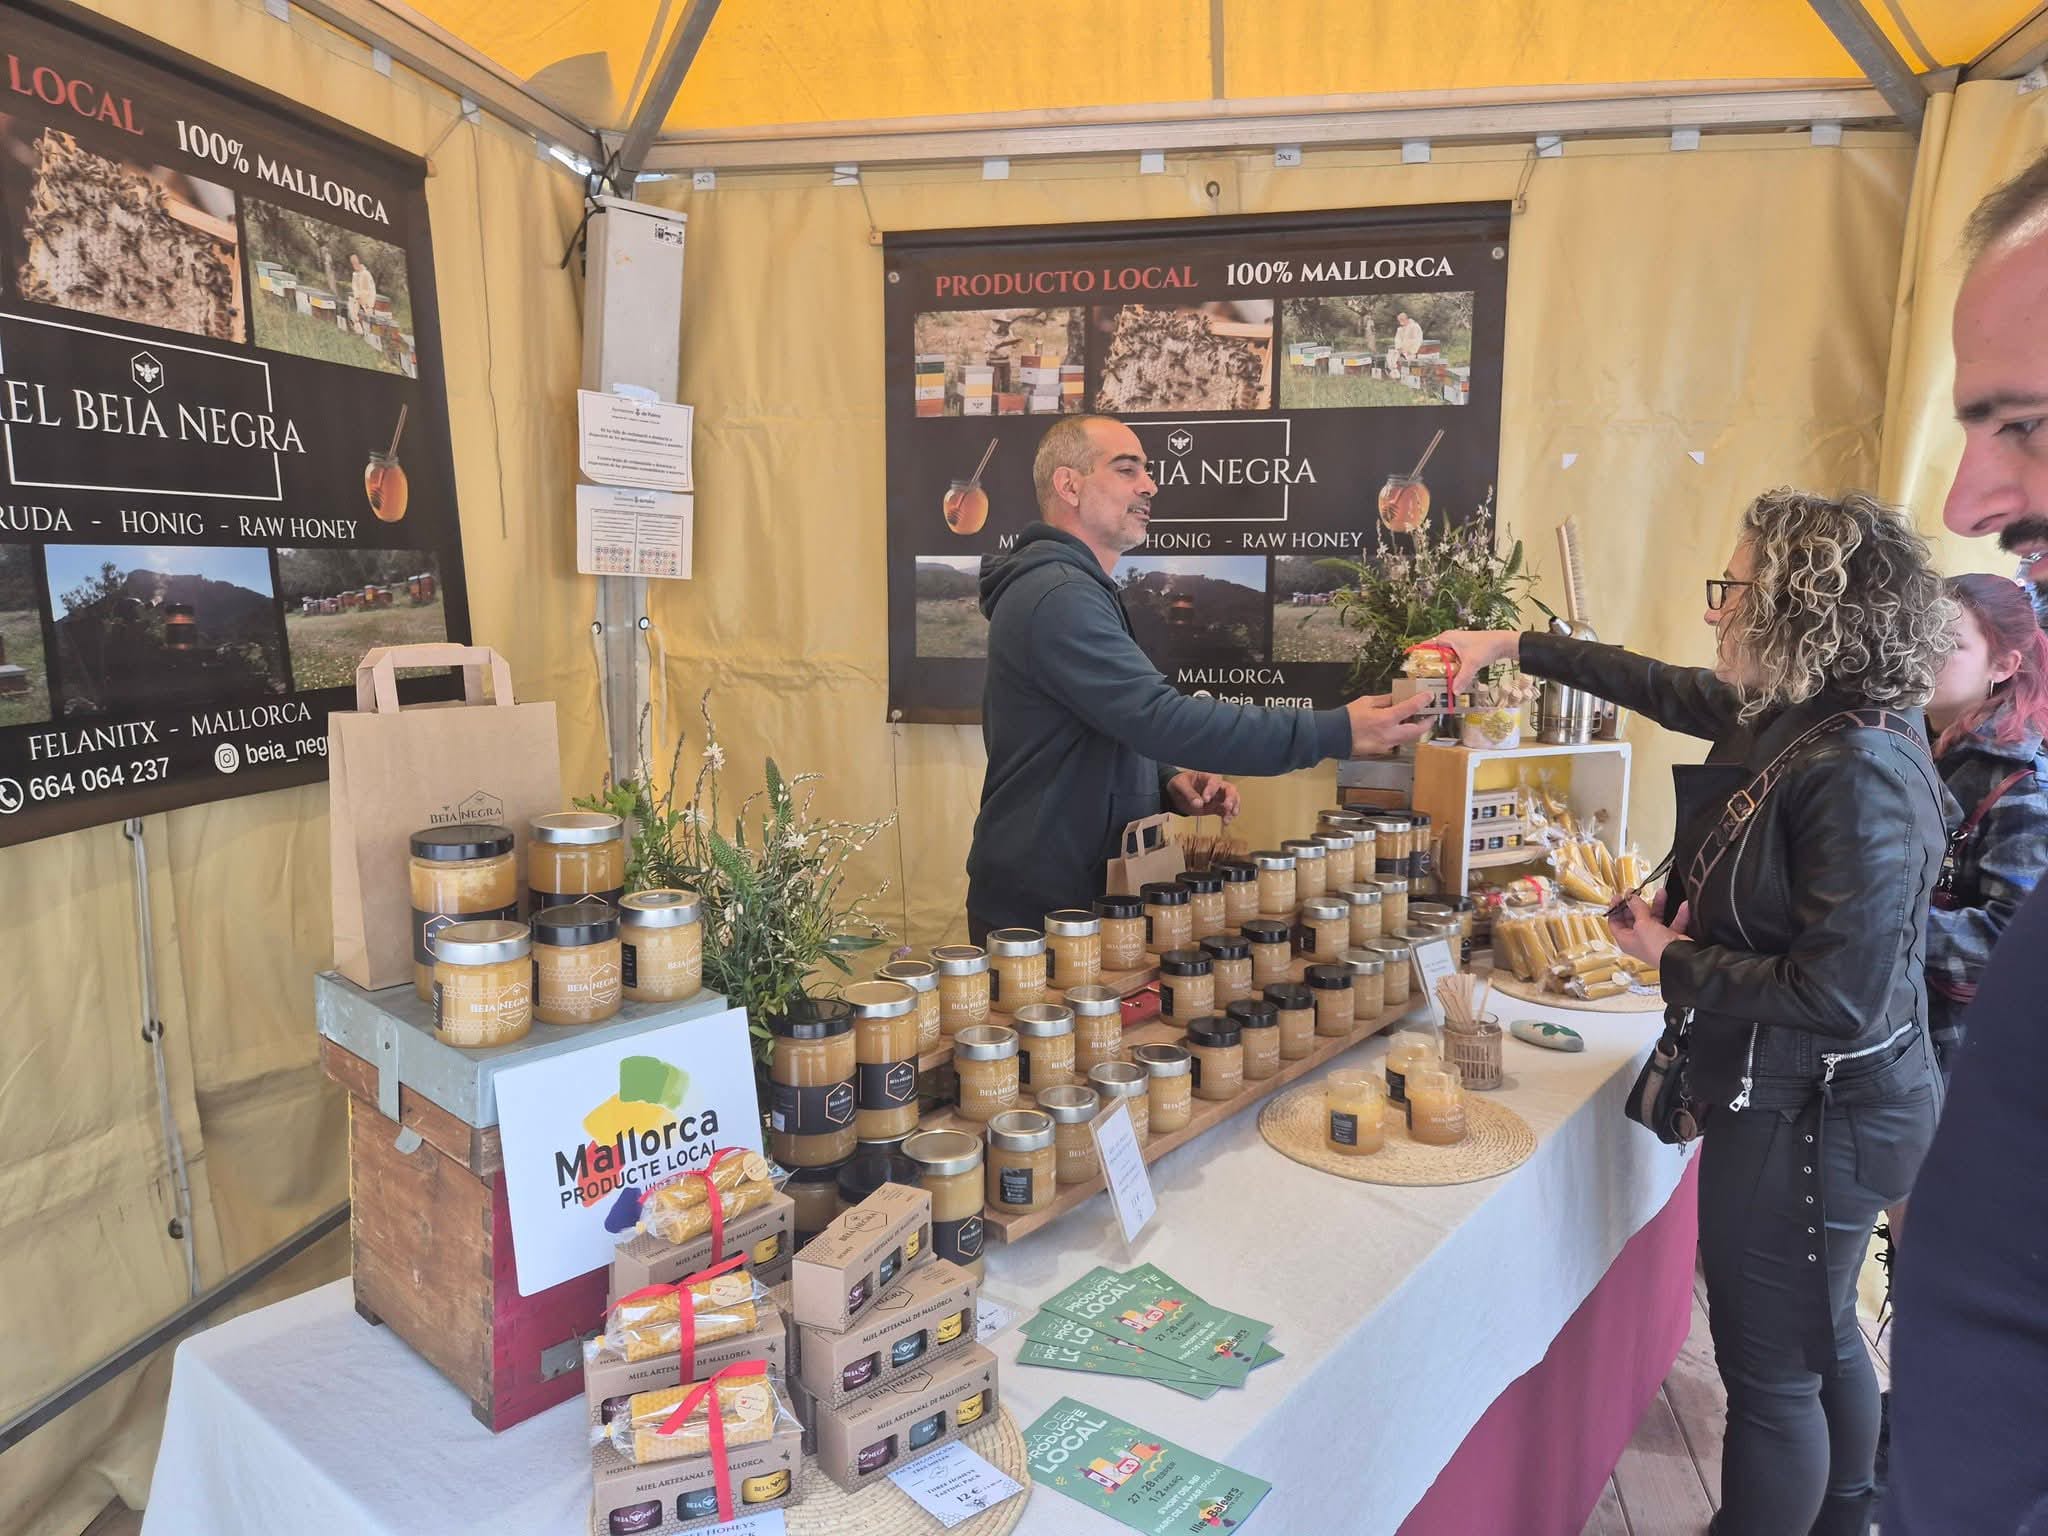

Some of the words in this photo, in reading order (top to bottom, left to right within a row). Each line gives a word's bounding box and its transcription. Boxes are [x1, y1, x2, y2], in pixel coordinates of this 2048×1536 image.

[7, 54, 145, 136] LOCAL
[176, 119, 250, 174] 100%
[256, 154, 390, 226] MALLORCA
[935, 270, 1096, 297] PRODUCTO
[1102, 265, 1199, 292] LOCAL
[1226, 260, 1293, 286] 100%
[1299, 256, 1456, 283] MALLORCA
[0, 379, 62, 428] EL
[71, 389, 169, 439] BEIA
[177, 403, 308, 454] NEGRA
[1199, 457, 1319, 486] NEGRA
[120, 510, 205, 536] HONIG
[239, 515, 285, 538] RAW
[291, 518, 358, 540] HONEY
[1145, 532, 1211, 549] HONIG
[1242, 532, 1287, 548] RAW
[1292, 531, 1364, 549] HONEY
[1176, 667, 1286, 685] MALLORCA
[28, 720, 161, 761] FELANITX
[191, 701, 313, 738] MALLORCA
[245, 735, 328, 766] beia_neg
[29, 772, 77, 802] 664
[81, 765, 126, 793] 064
[131, 756, 170, 784] 237
[460, 806, 502, 821] NEGRA
[470, 1002, 497, 1014] BEIA
[555, 1109, 719, 1187] Mallorca
[560, 1159, 661, 1209] PRODUCTE
[921, 1297, 953, 1316] MALLORCA
[1076, 1283, 1137, 1320] LOCAL
[709, 1349, 752, 1364] MALLORCA
[938, 1382, 972, 1403] MALLORCA
[1034, 1420, 1108, 1474] LOCAL
[636, 1483, 658, 1493] MIEL
[657, 1471, 704, 1489] ARTESANAL
[726, 1457, 765, 1472] ALLORCA
[1128, 1492, 1141, 1505] 27
[1206, 1486, 1241, 1518] Balears
